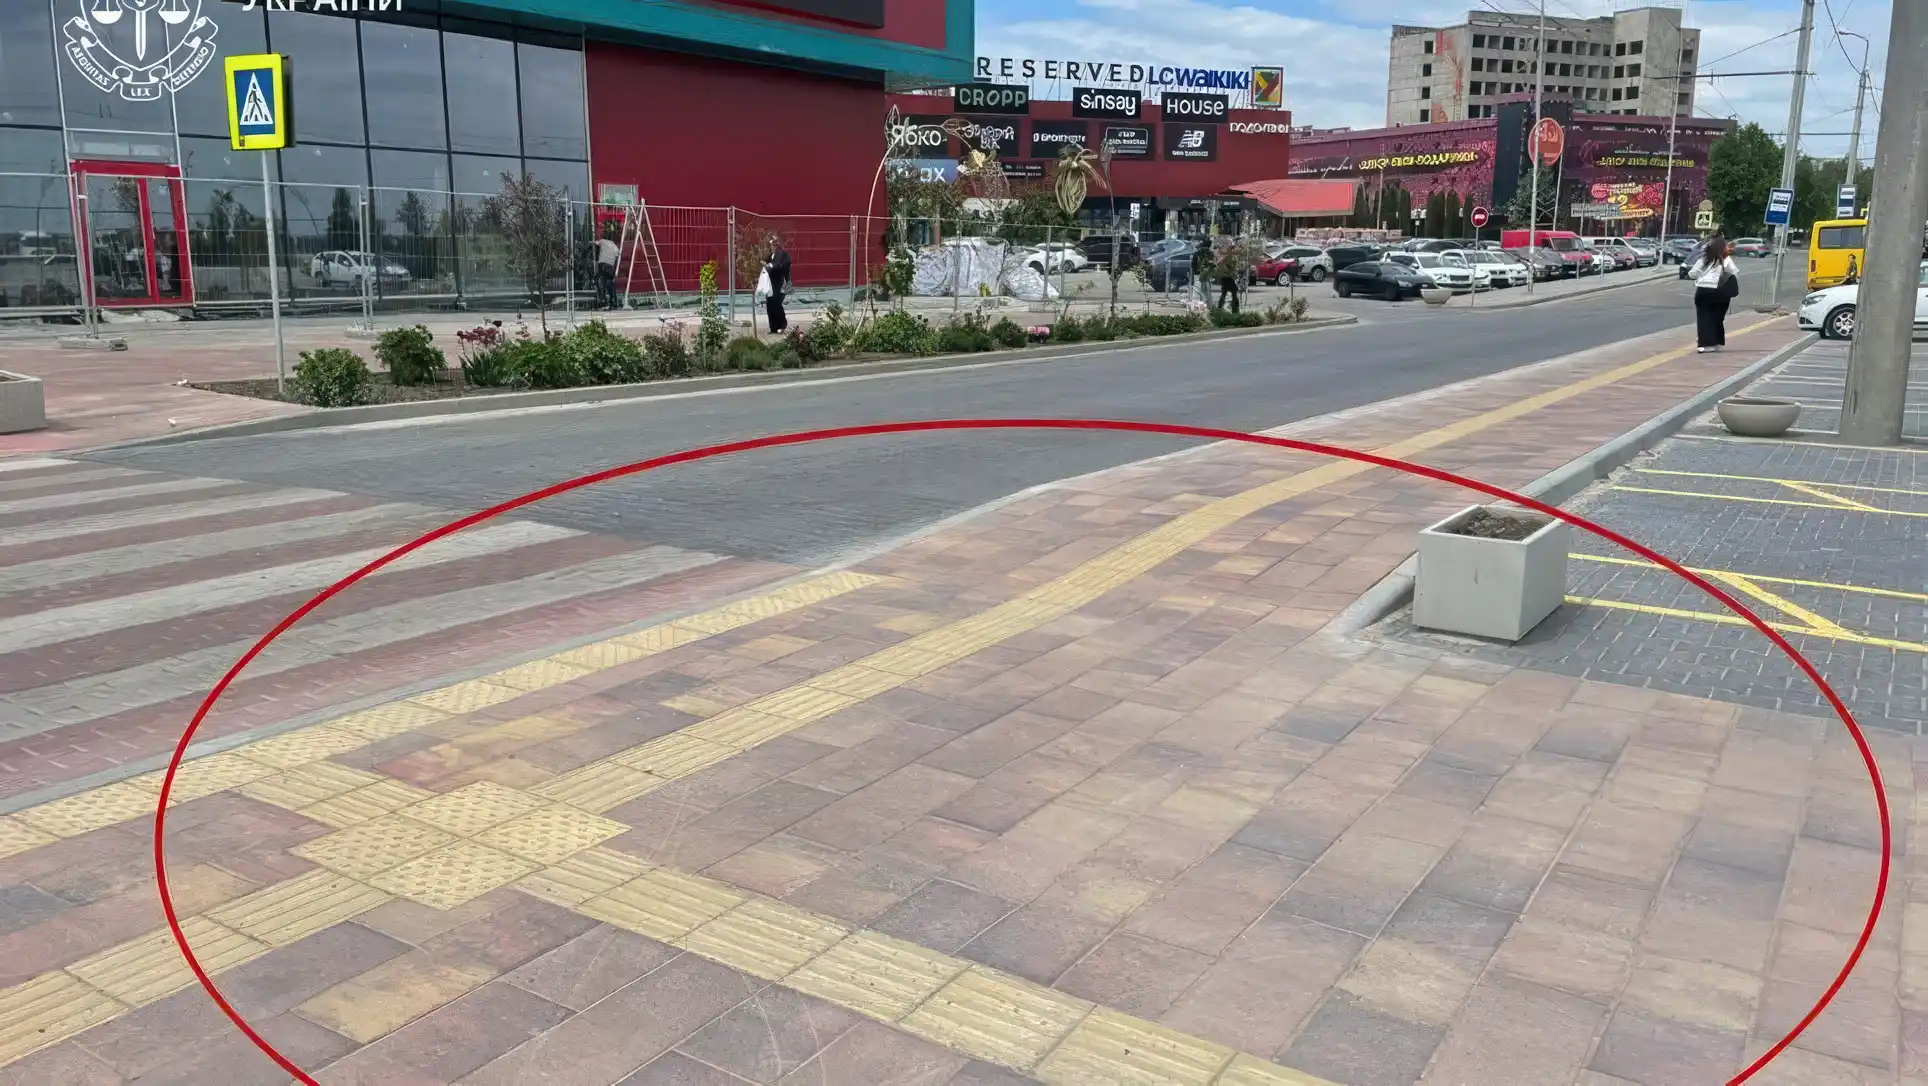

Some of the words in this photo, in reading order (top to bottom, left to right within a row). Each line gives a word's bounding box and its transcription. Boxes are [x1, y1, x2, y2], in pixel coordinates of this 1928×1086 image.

[976, 56, 1145, 83] RESERVED
[959, 87, 1027, 108] CROPP
[1080, 88, 1137, 116] sinsay
